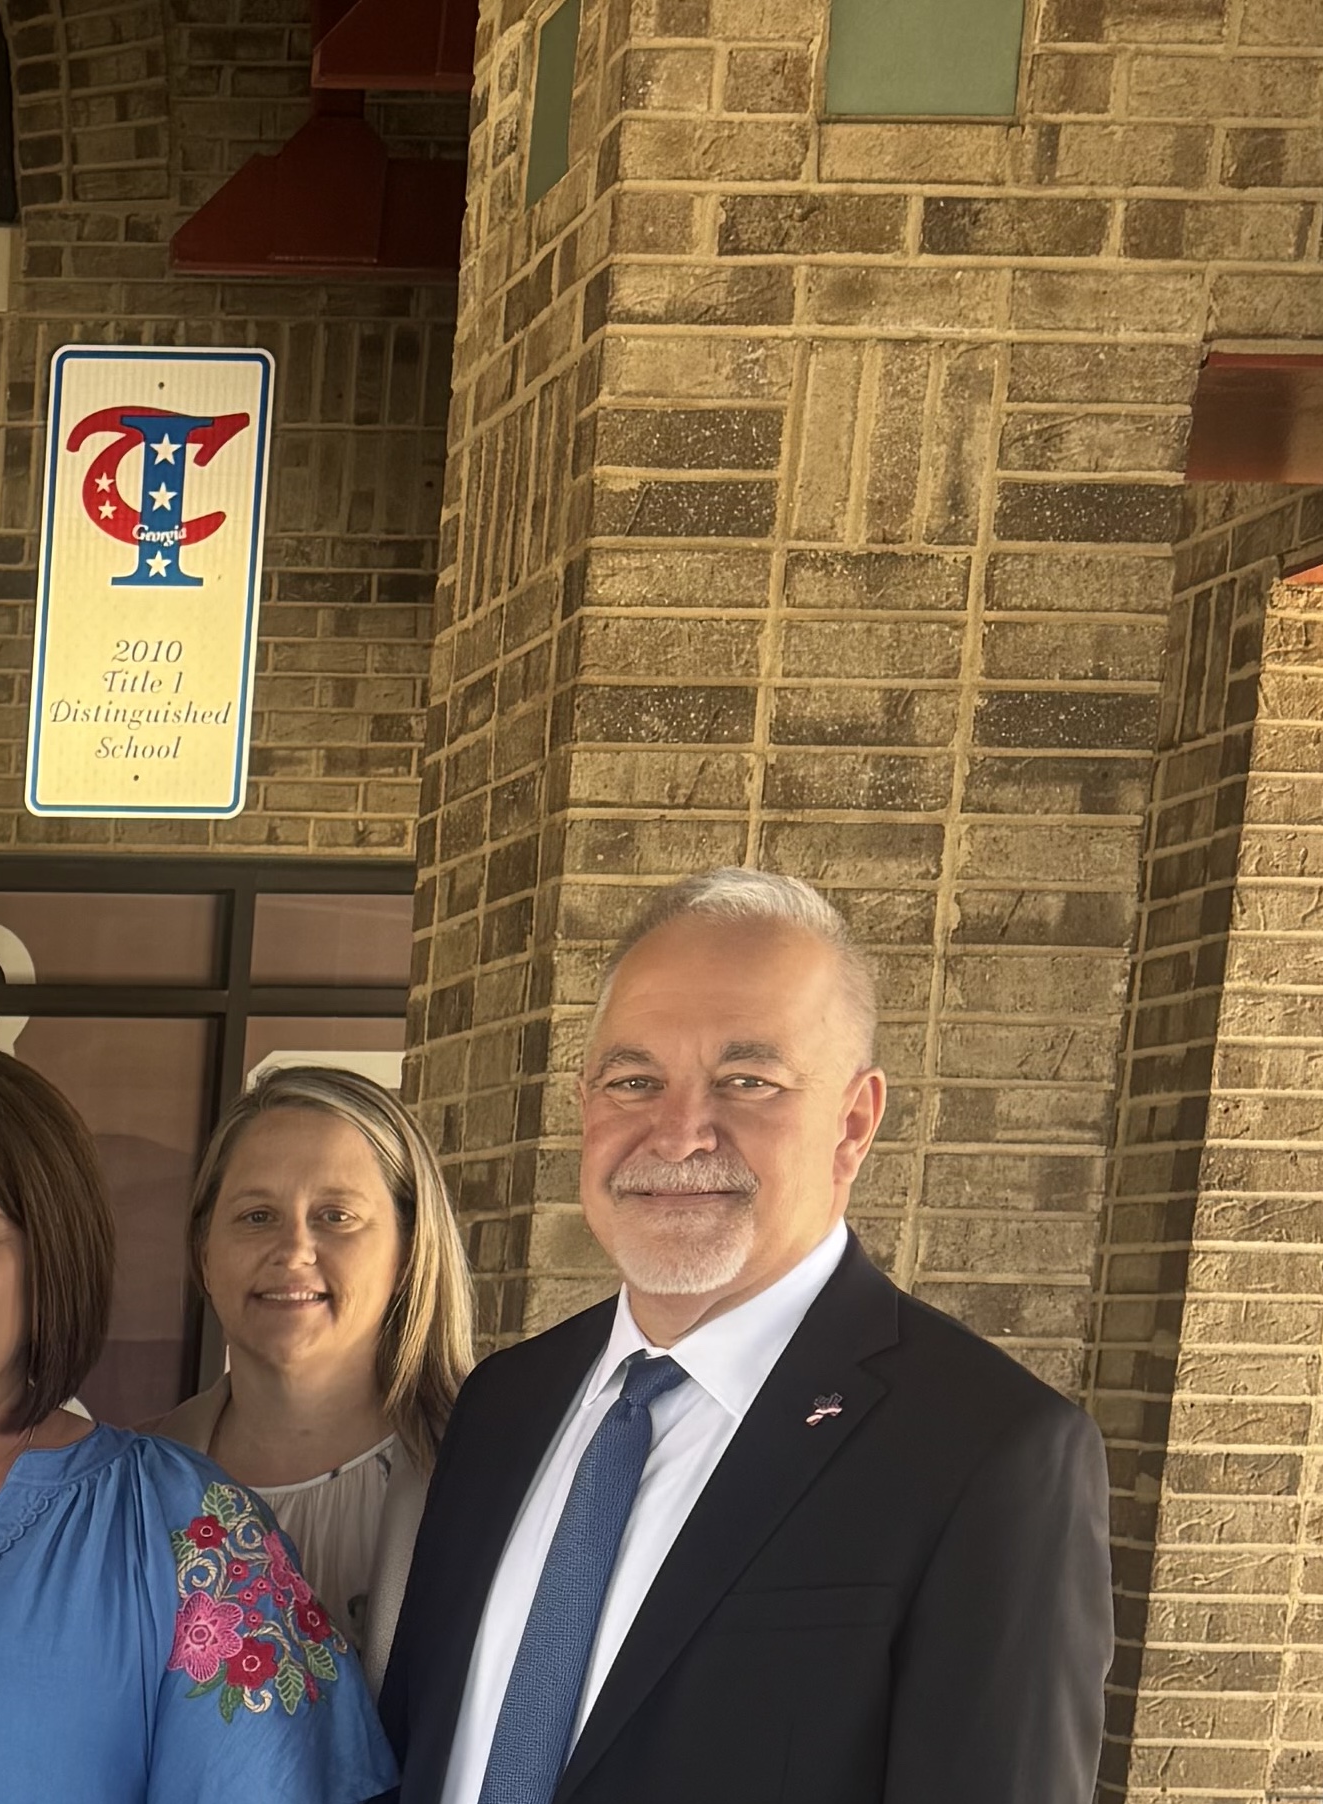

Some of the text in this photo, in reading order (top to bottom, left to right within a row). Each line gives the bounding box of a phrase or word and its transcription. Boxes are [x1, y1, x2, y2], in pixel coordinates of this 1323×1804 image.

[132, 523, 187, 546] Georgia
[112, 640, 182, 662] 2010
[104, 669, 162, 692] Title
[50, 699, 231, 729] Distinguished
[95, 736, 181, 758] School
